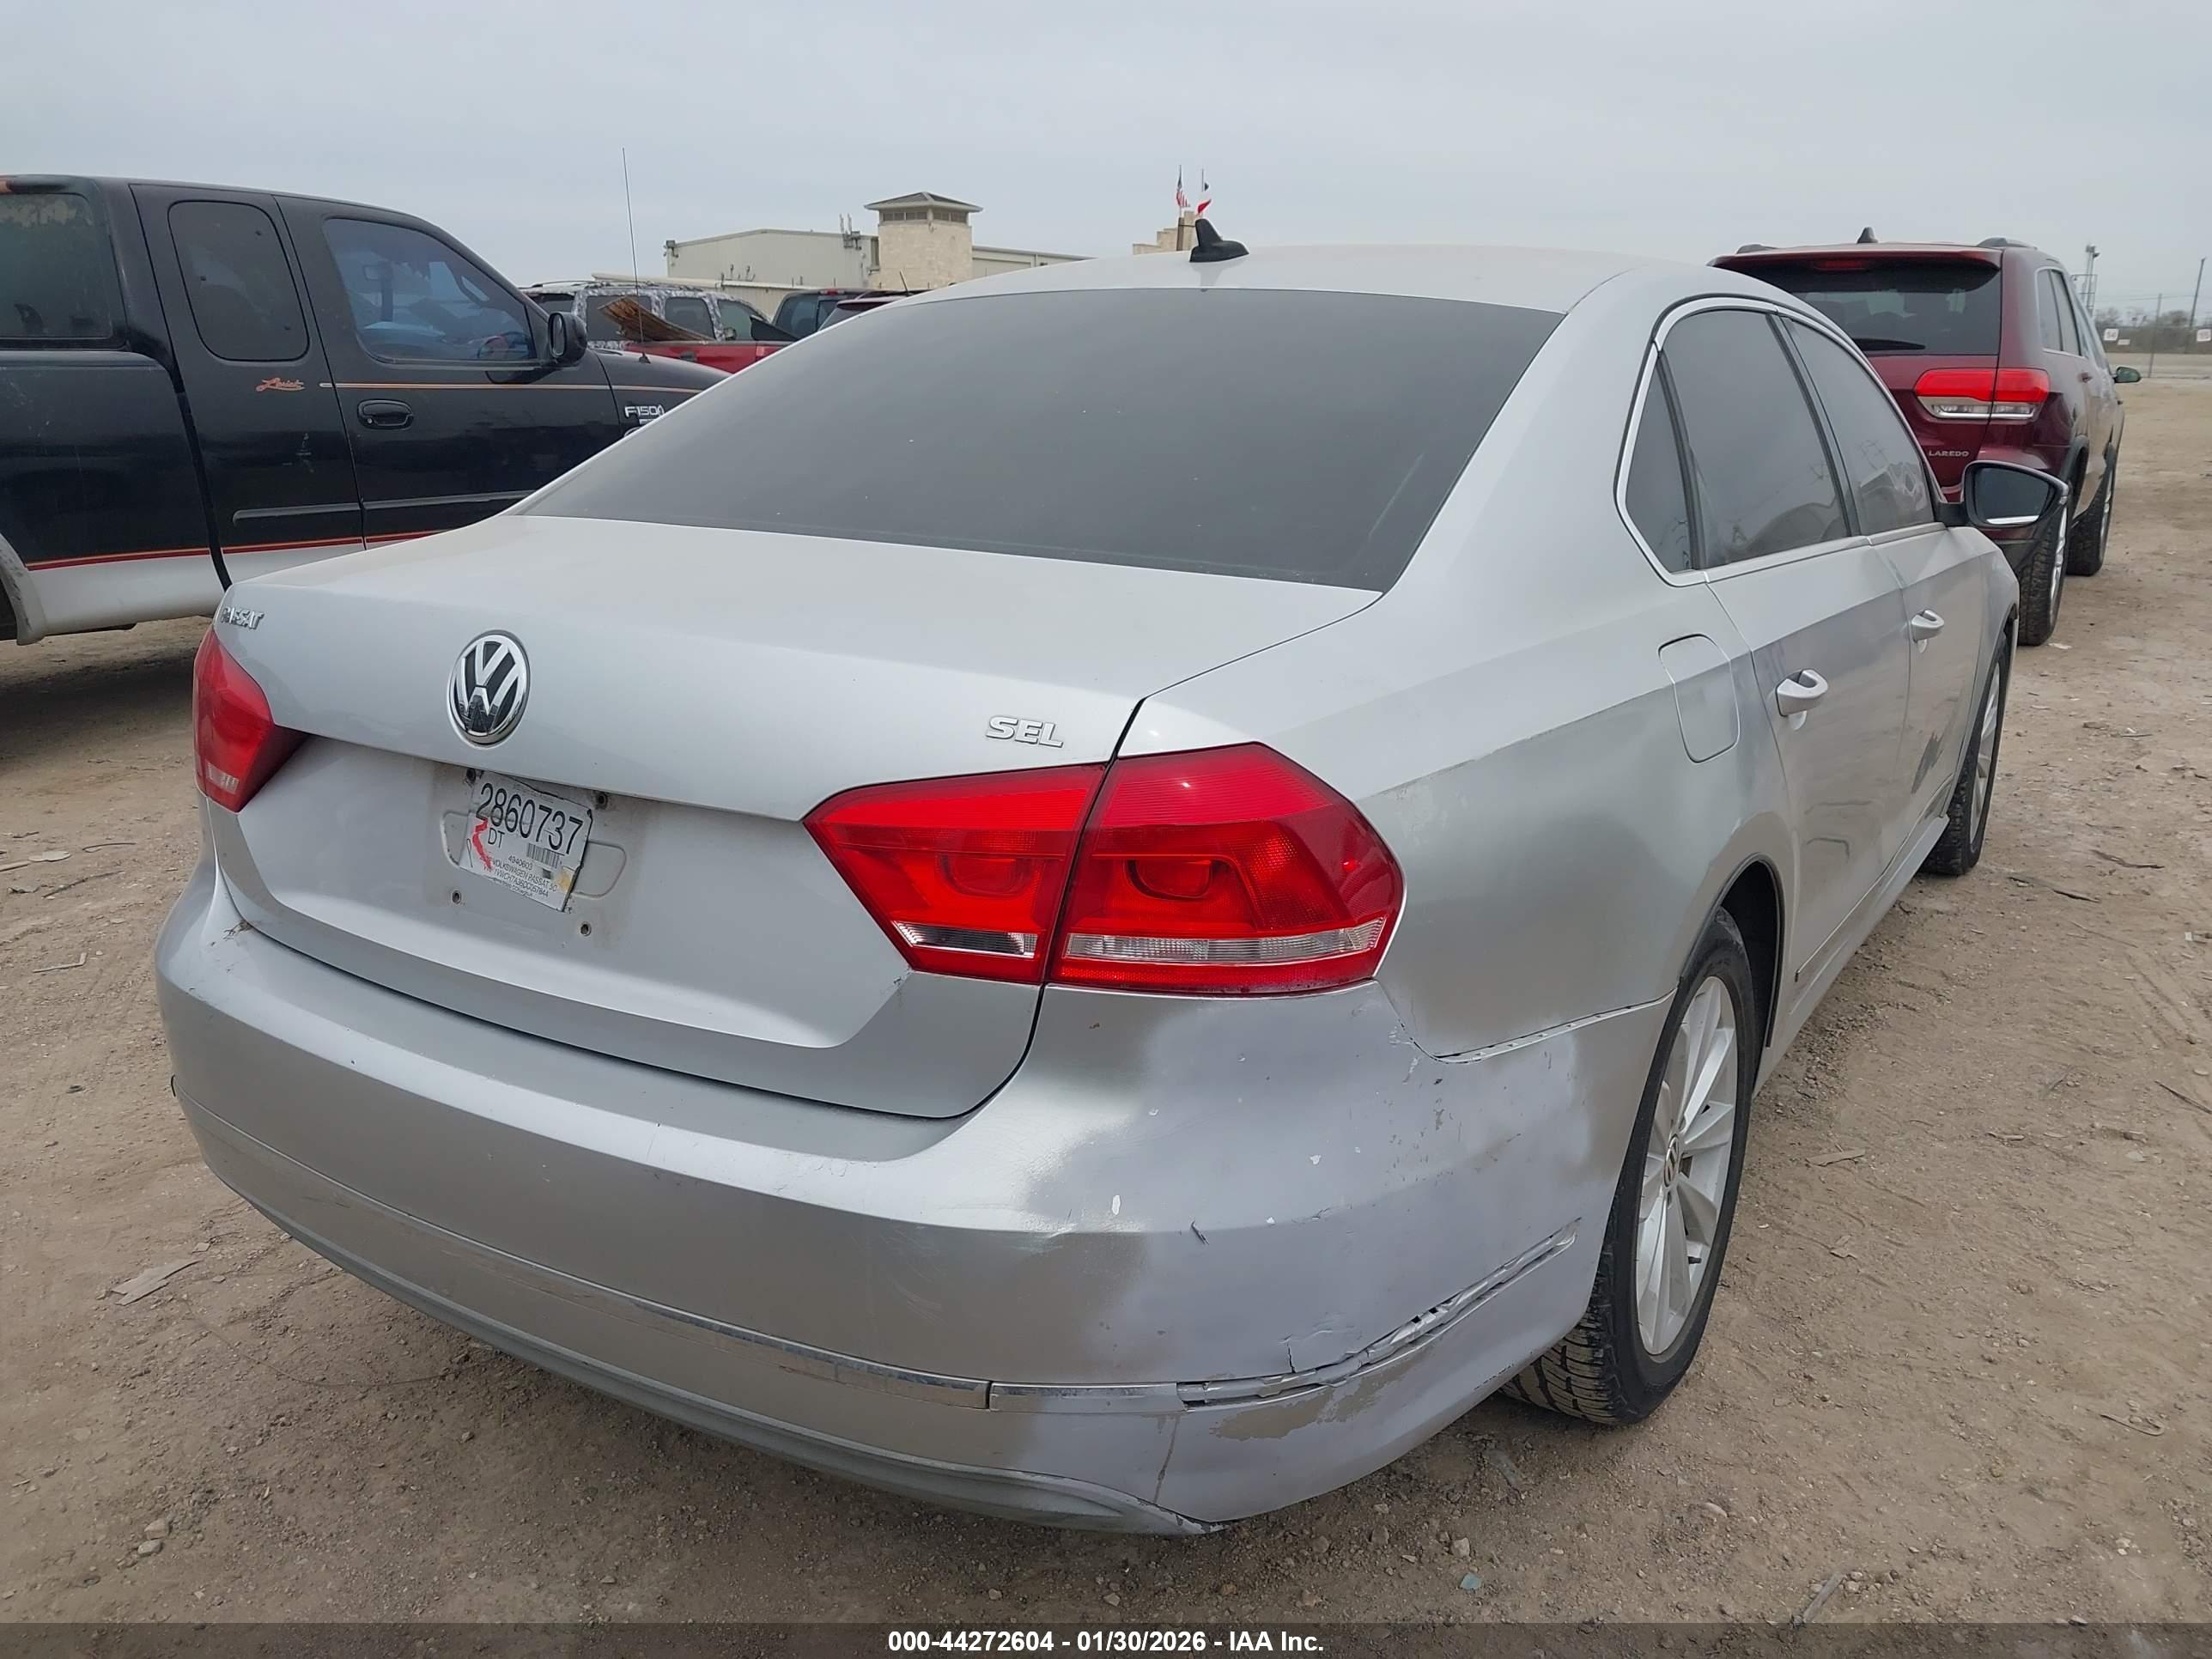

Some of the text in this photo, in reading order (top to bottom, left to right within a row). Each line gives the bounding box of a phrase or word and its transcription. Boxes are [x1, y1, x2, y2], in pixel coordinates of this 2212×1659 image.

[985, 715, 1064, 749] SEL
[476, 782, 583, 854] 2860737
[488, 827, 505, 848] DT
[528, 872, 550, 886] PASSAT
